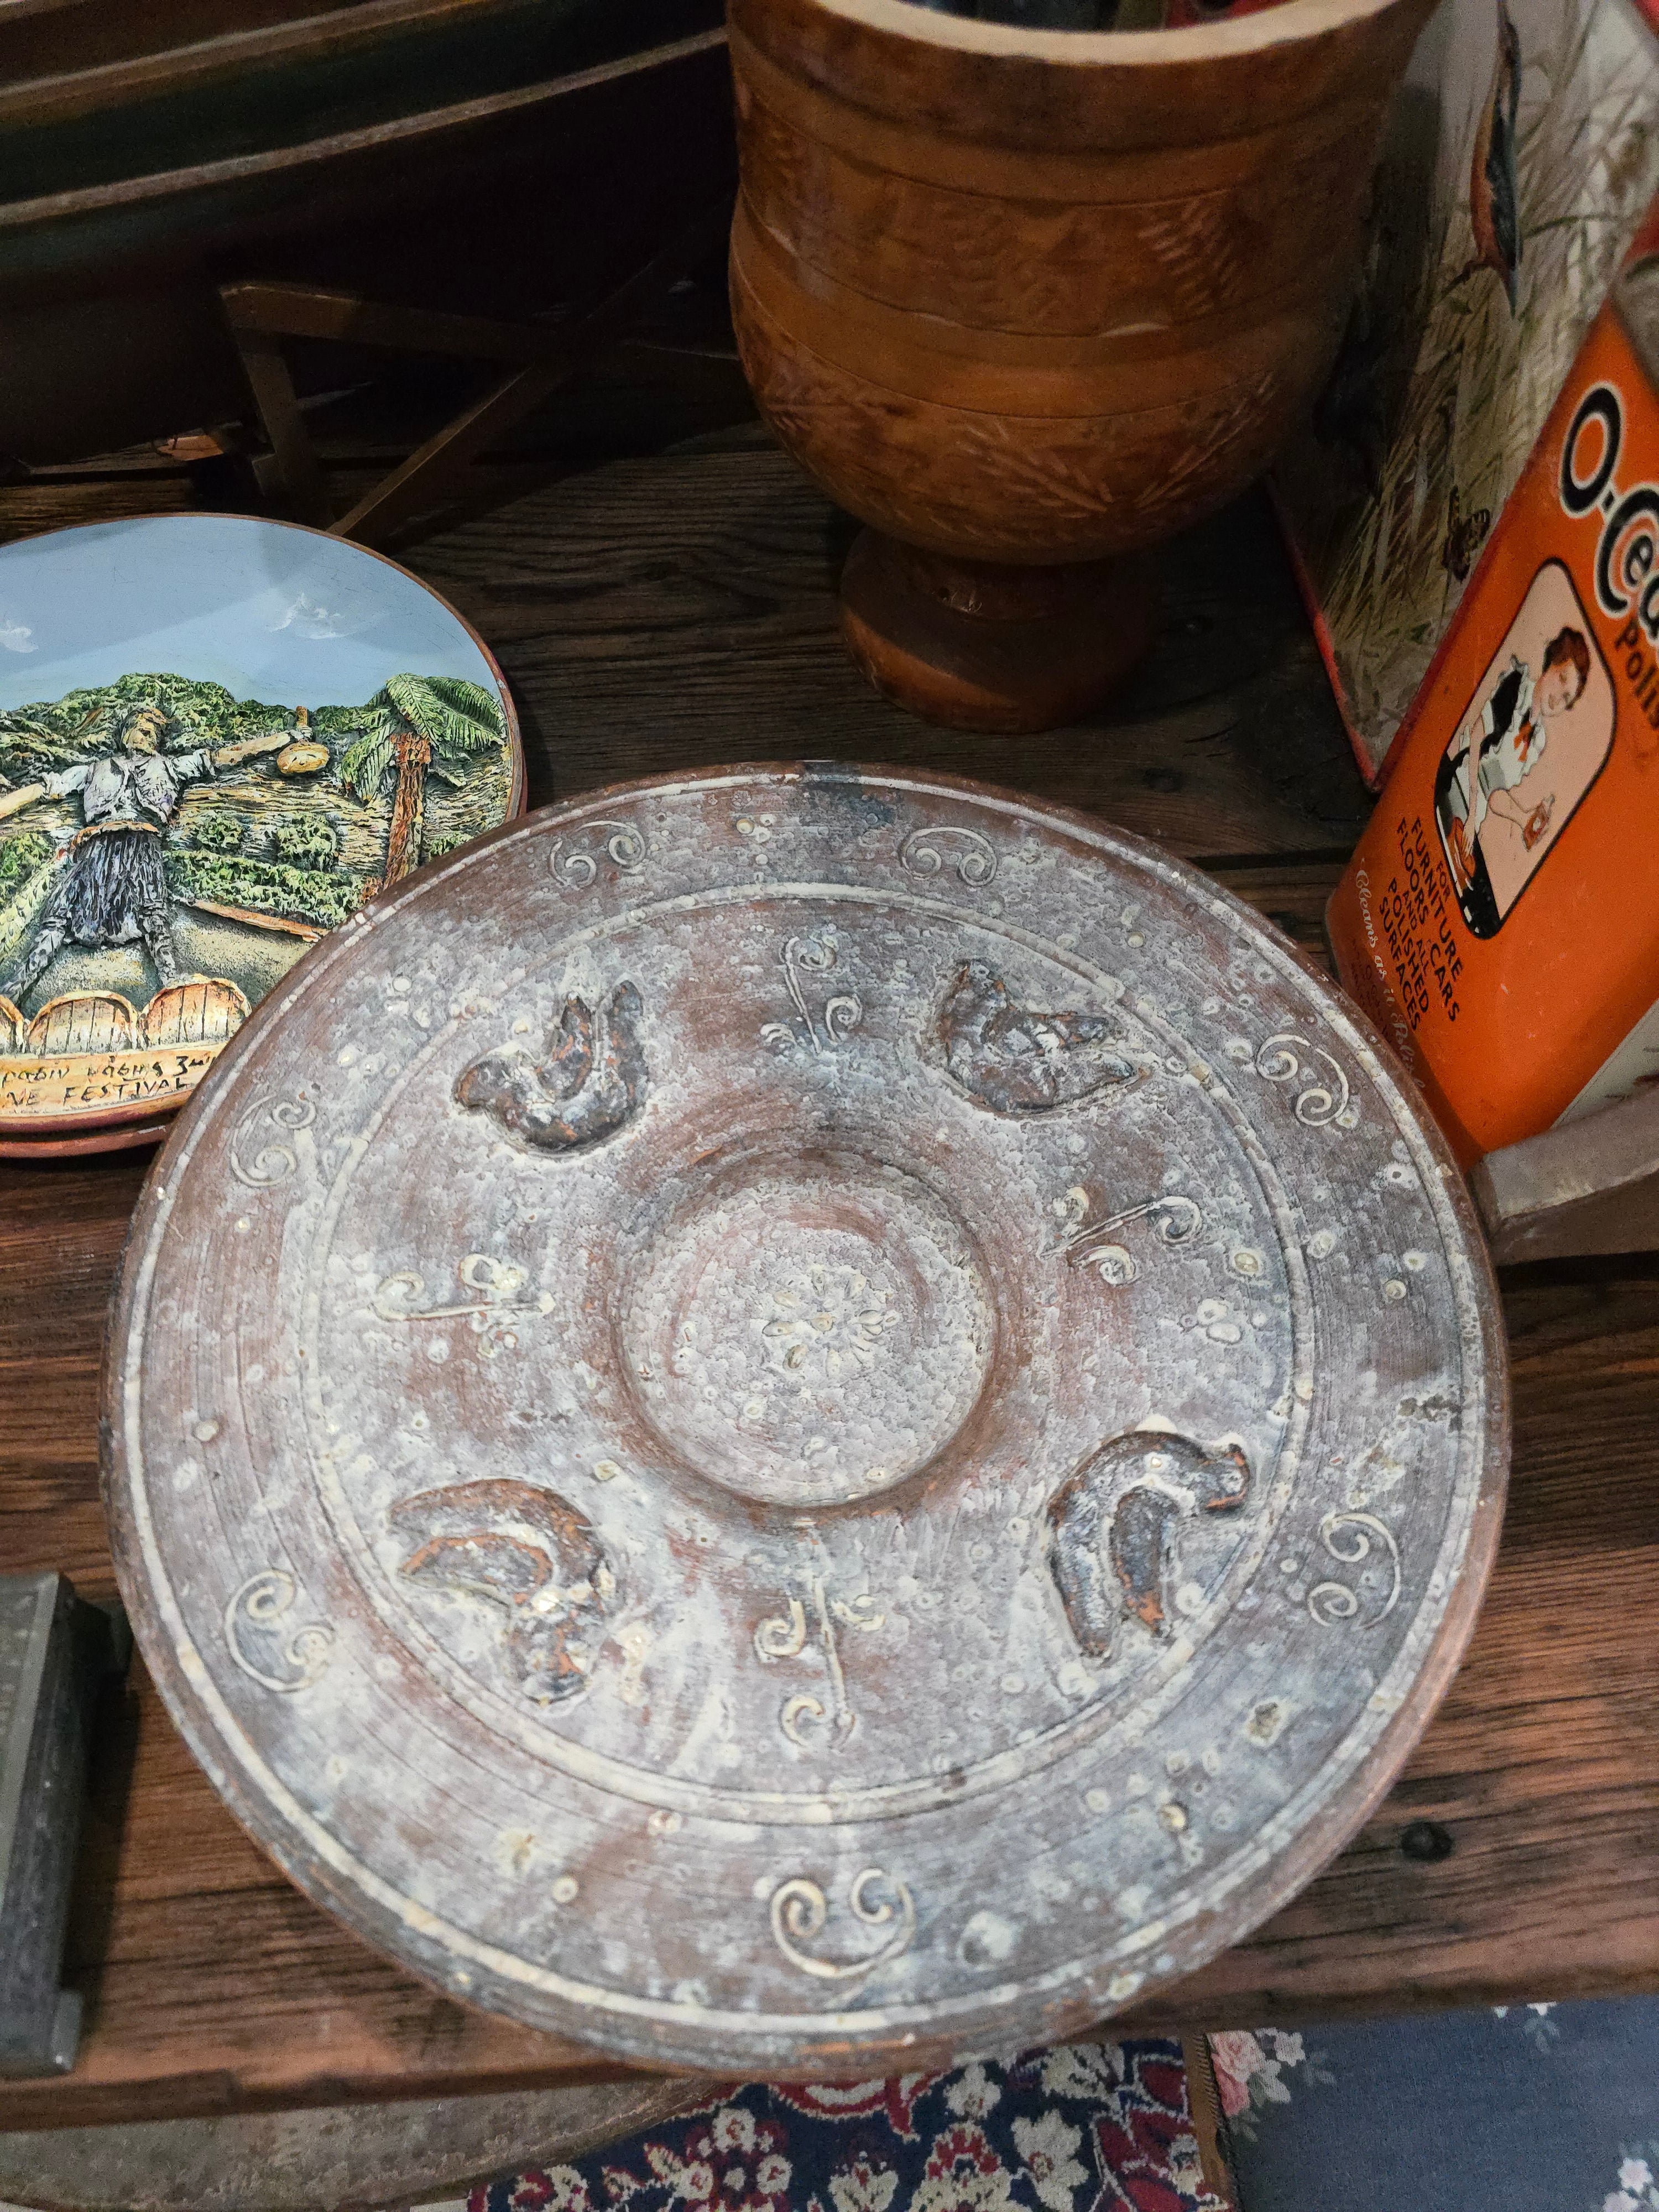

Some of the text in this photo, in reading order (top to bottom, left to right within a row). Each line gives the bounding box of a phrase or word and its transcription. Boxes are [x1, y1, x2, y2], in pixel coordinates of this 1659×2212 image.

[1387, 877, 1430, 1014] POLISHED
[1397, 817, 1460, 1022] FLOORS CARS
[1402, 889, 1428, 977] AND ALL
[1411, 817, 1464, 980] FURNITURE
[1436, 860, 1451, 900] FOR
[1379, 896, 1421, 1031] SURFACES
[62, 1077, 189, 1108] FESTIVAL
